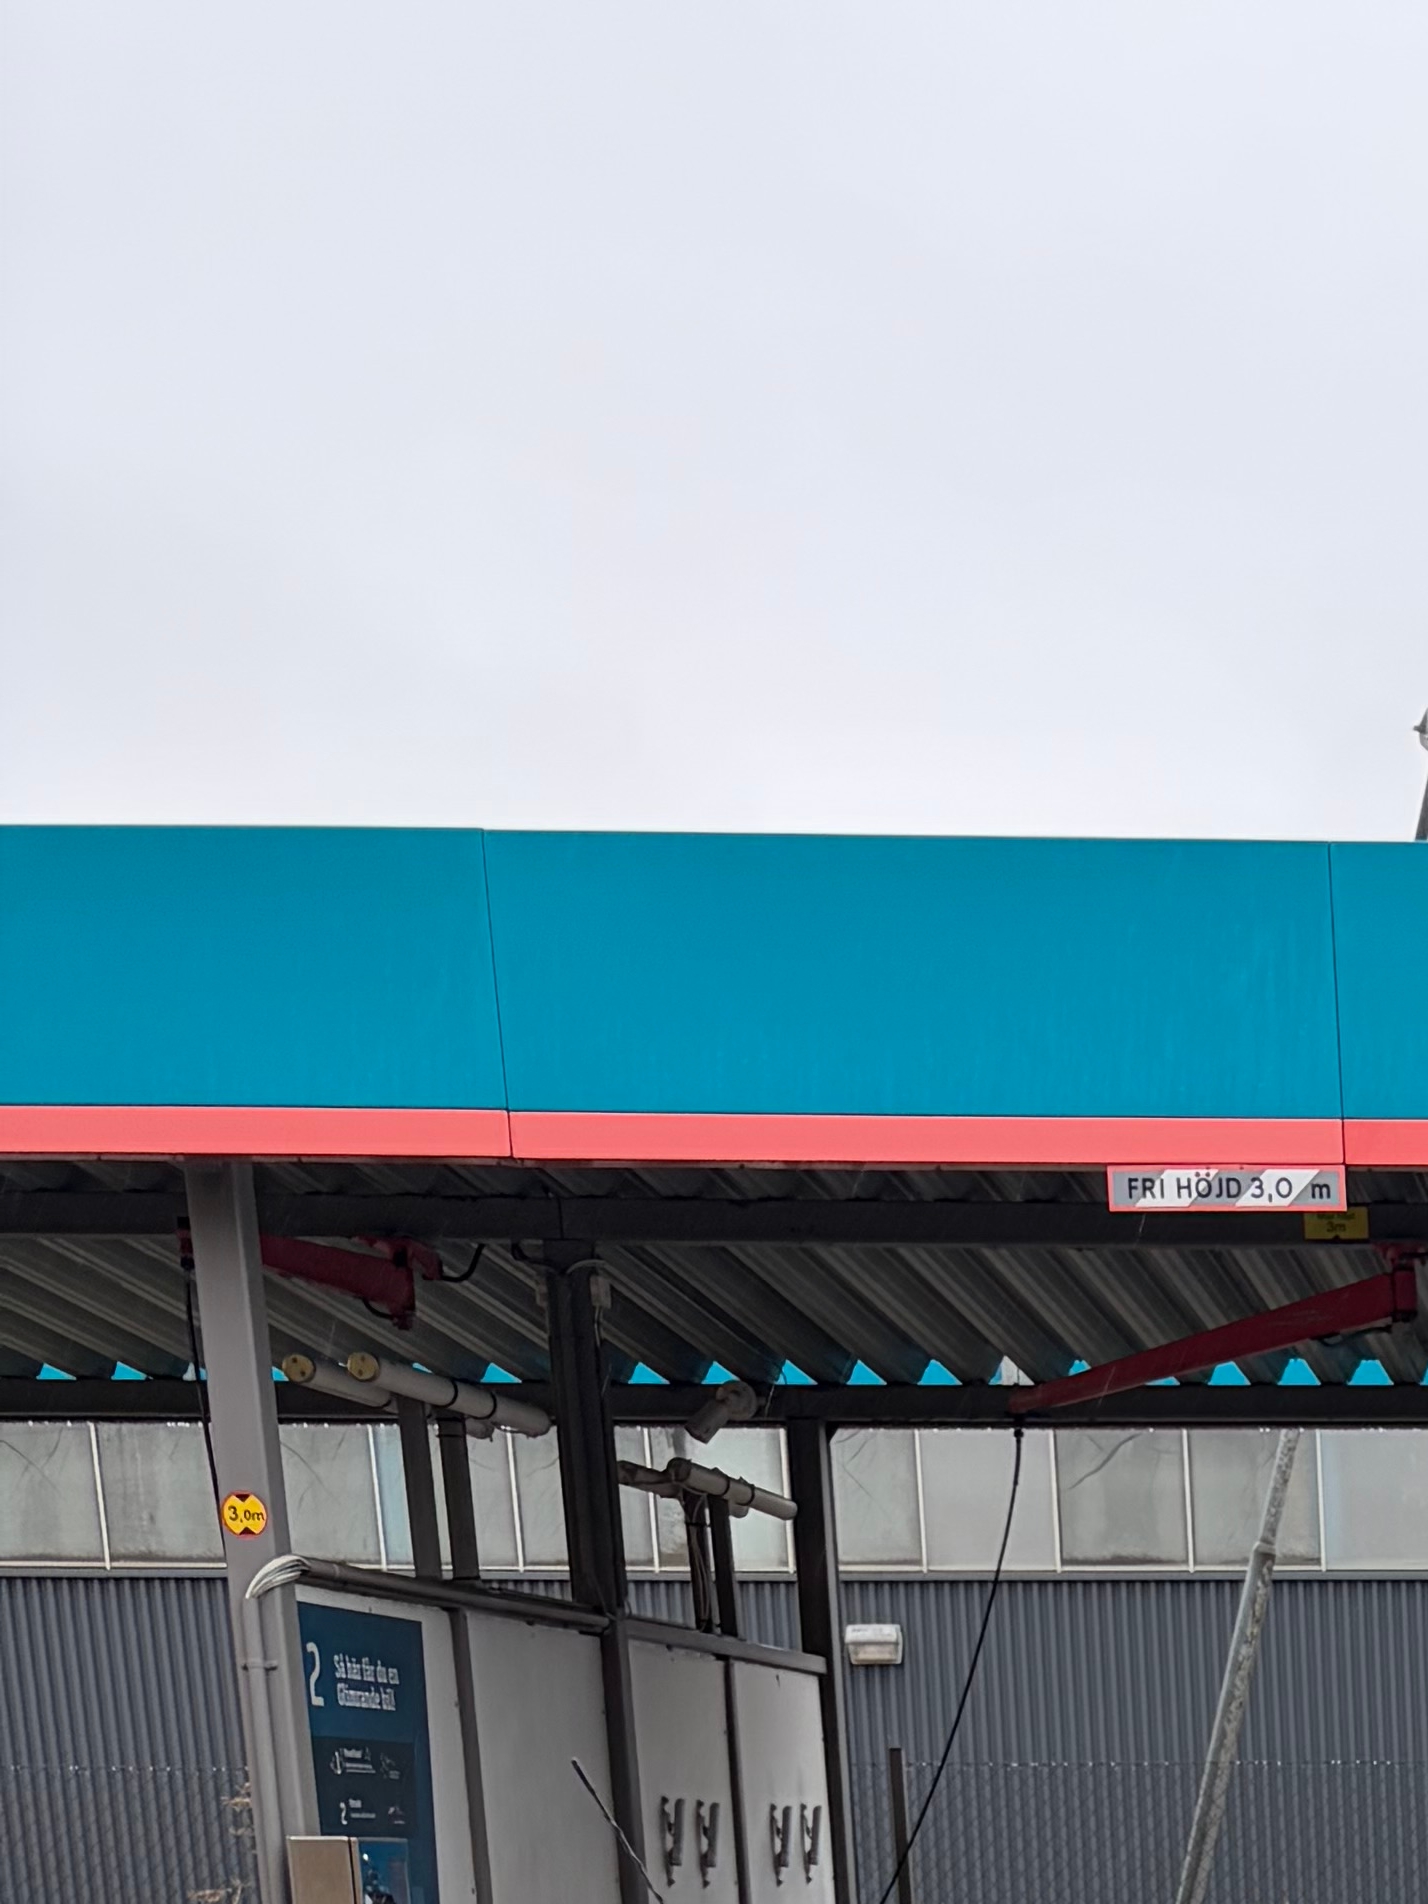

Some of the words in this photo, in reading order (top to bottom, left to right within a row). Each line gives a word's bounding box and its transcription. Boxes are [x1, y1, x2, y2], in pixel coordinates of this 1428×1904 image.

[1127, 1177, 1164, 1199] FRI
[1176, 1171, 1242, 1199] HÖJD
[1250, 1176, 1293, 1203] 3,0
[1310, 1182, 1331, 1199] m
[227, 1505, 265, 1523] 3,0m
[306, 1642, 325, 1707] 2
